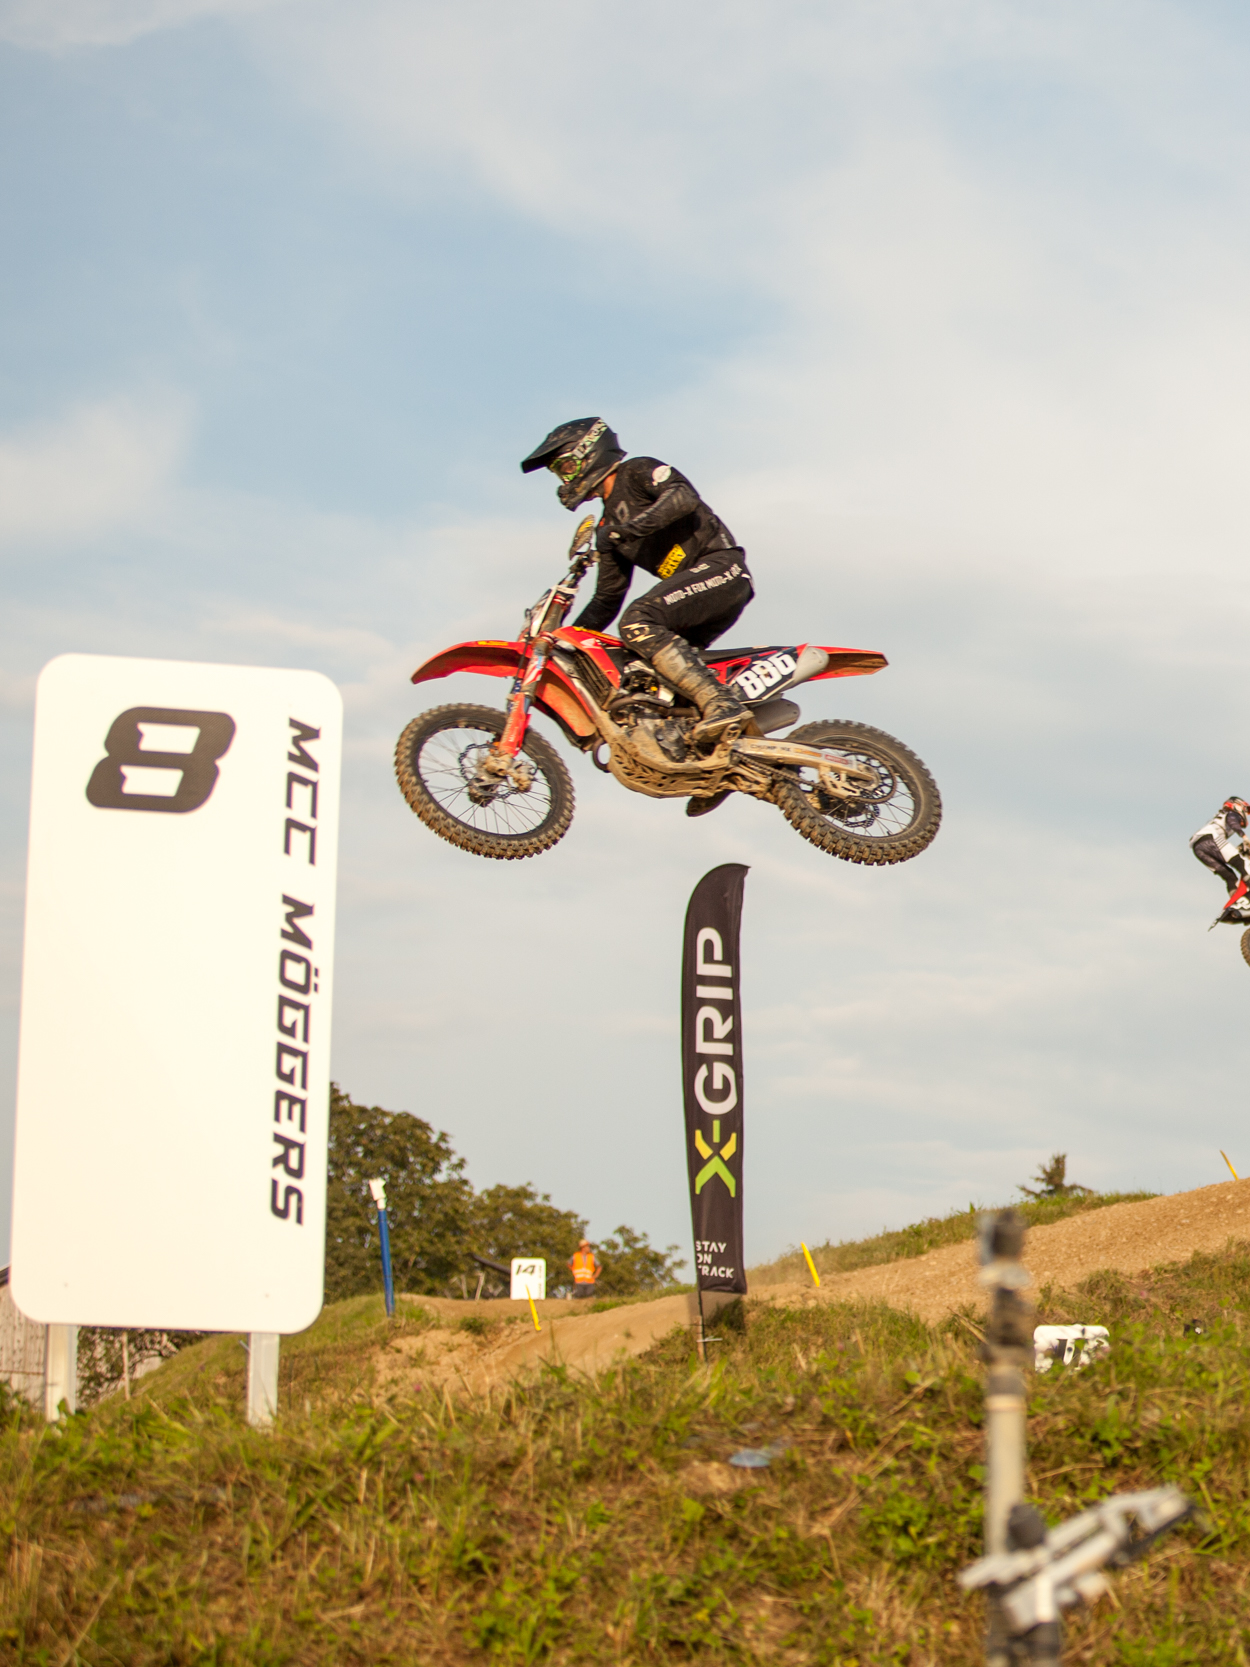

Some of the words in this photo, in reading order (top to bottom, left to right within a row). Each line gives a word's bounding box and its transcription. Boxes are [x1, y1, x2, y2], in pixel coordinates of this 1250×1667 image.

[735, 652, 797, 699] 886
[85, 706, 237, 814] 8
[283, 716, 321, 866] MCC
[270, 893, 321, 1226] MÖGGERS
[694, 926, 738, 1197] X-GRIP
[515, 1264, 536, 1276] 14
[695, 1240, 727, 1254] STAY
